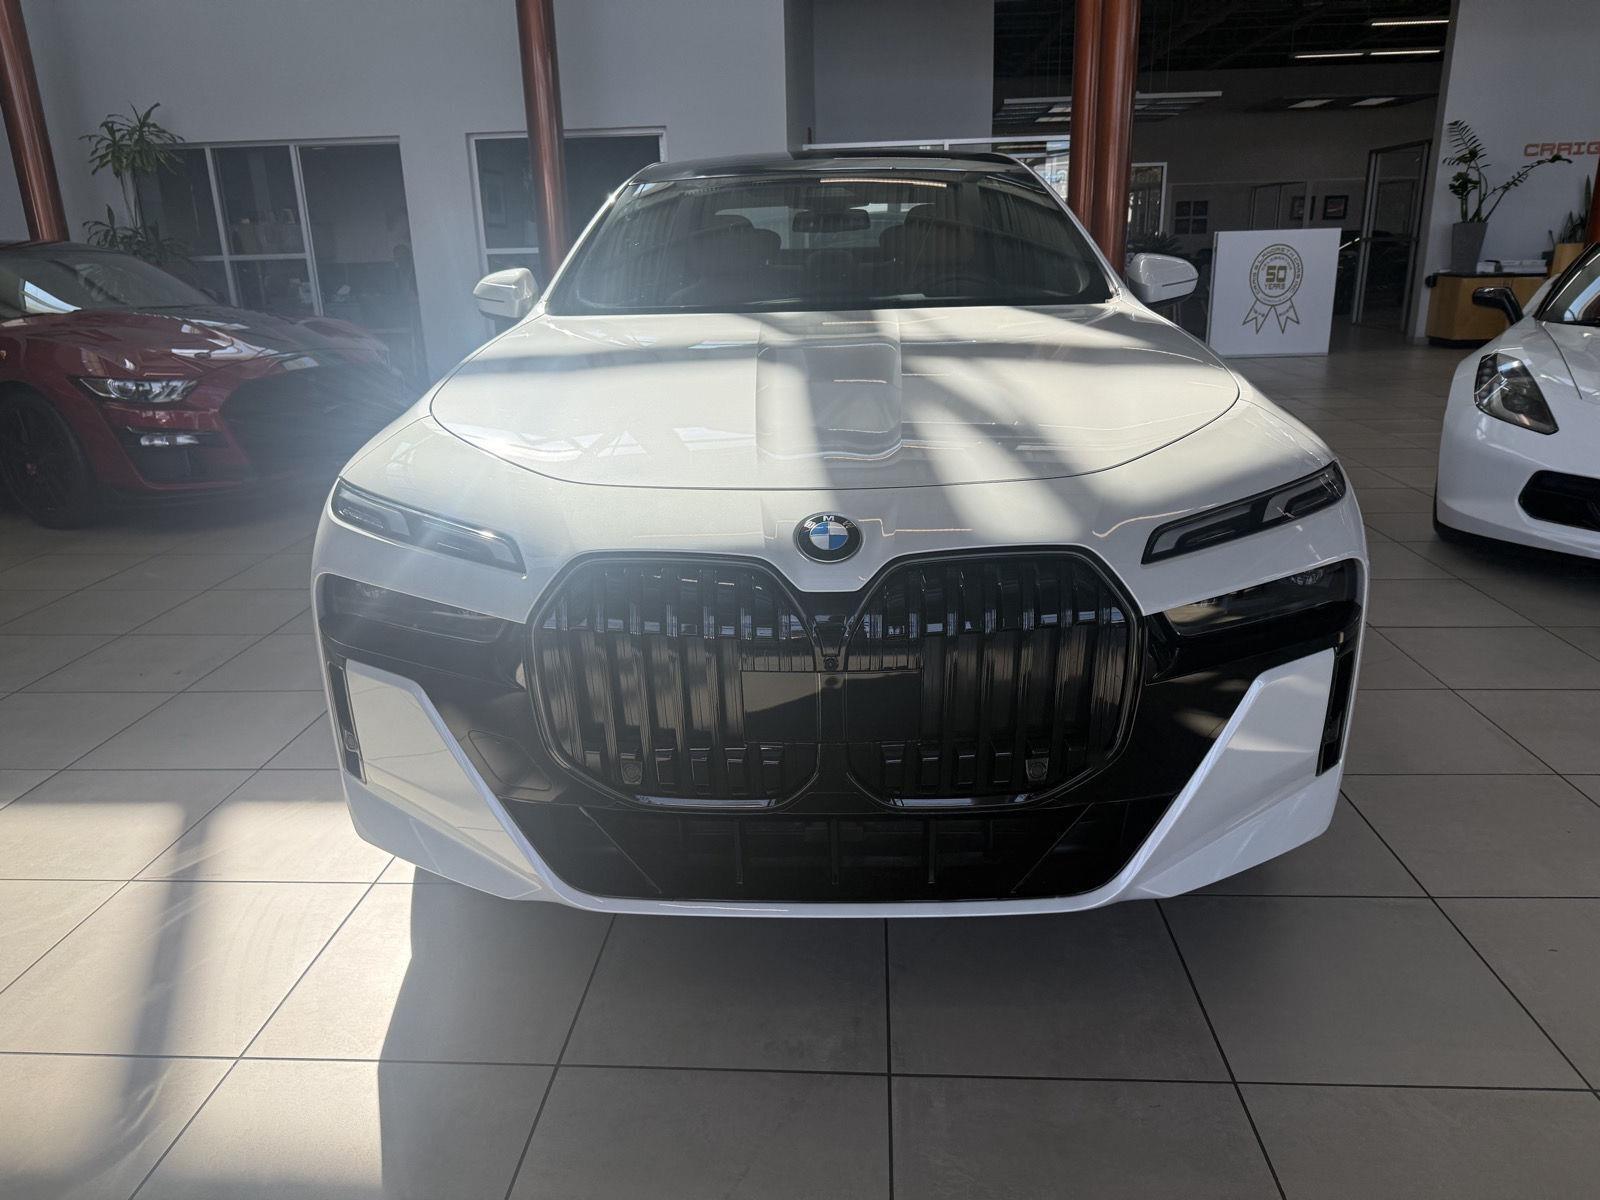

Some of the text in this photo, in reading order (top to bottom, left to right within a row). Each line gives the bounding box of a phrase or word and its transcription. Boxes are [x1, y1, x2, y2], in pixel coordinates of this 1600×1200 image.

[1524, 141, 1600, 156] CRAIG
[1266, 265, 1288, 282] 50
[1265, 282, 1286, 290] YEARS
[803, 515, 854, 529] BMW
